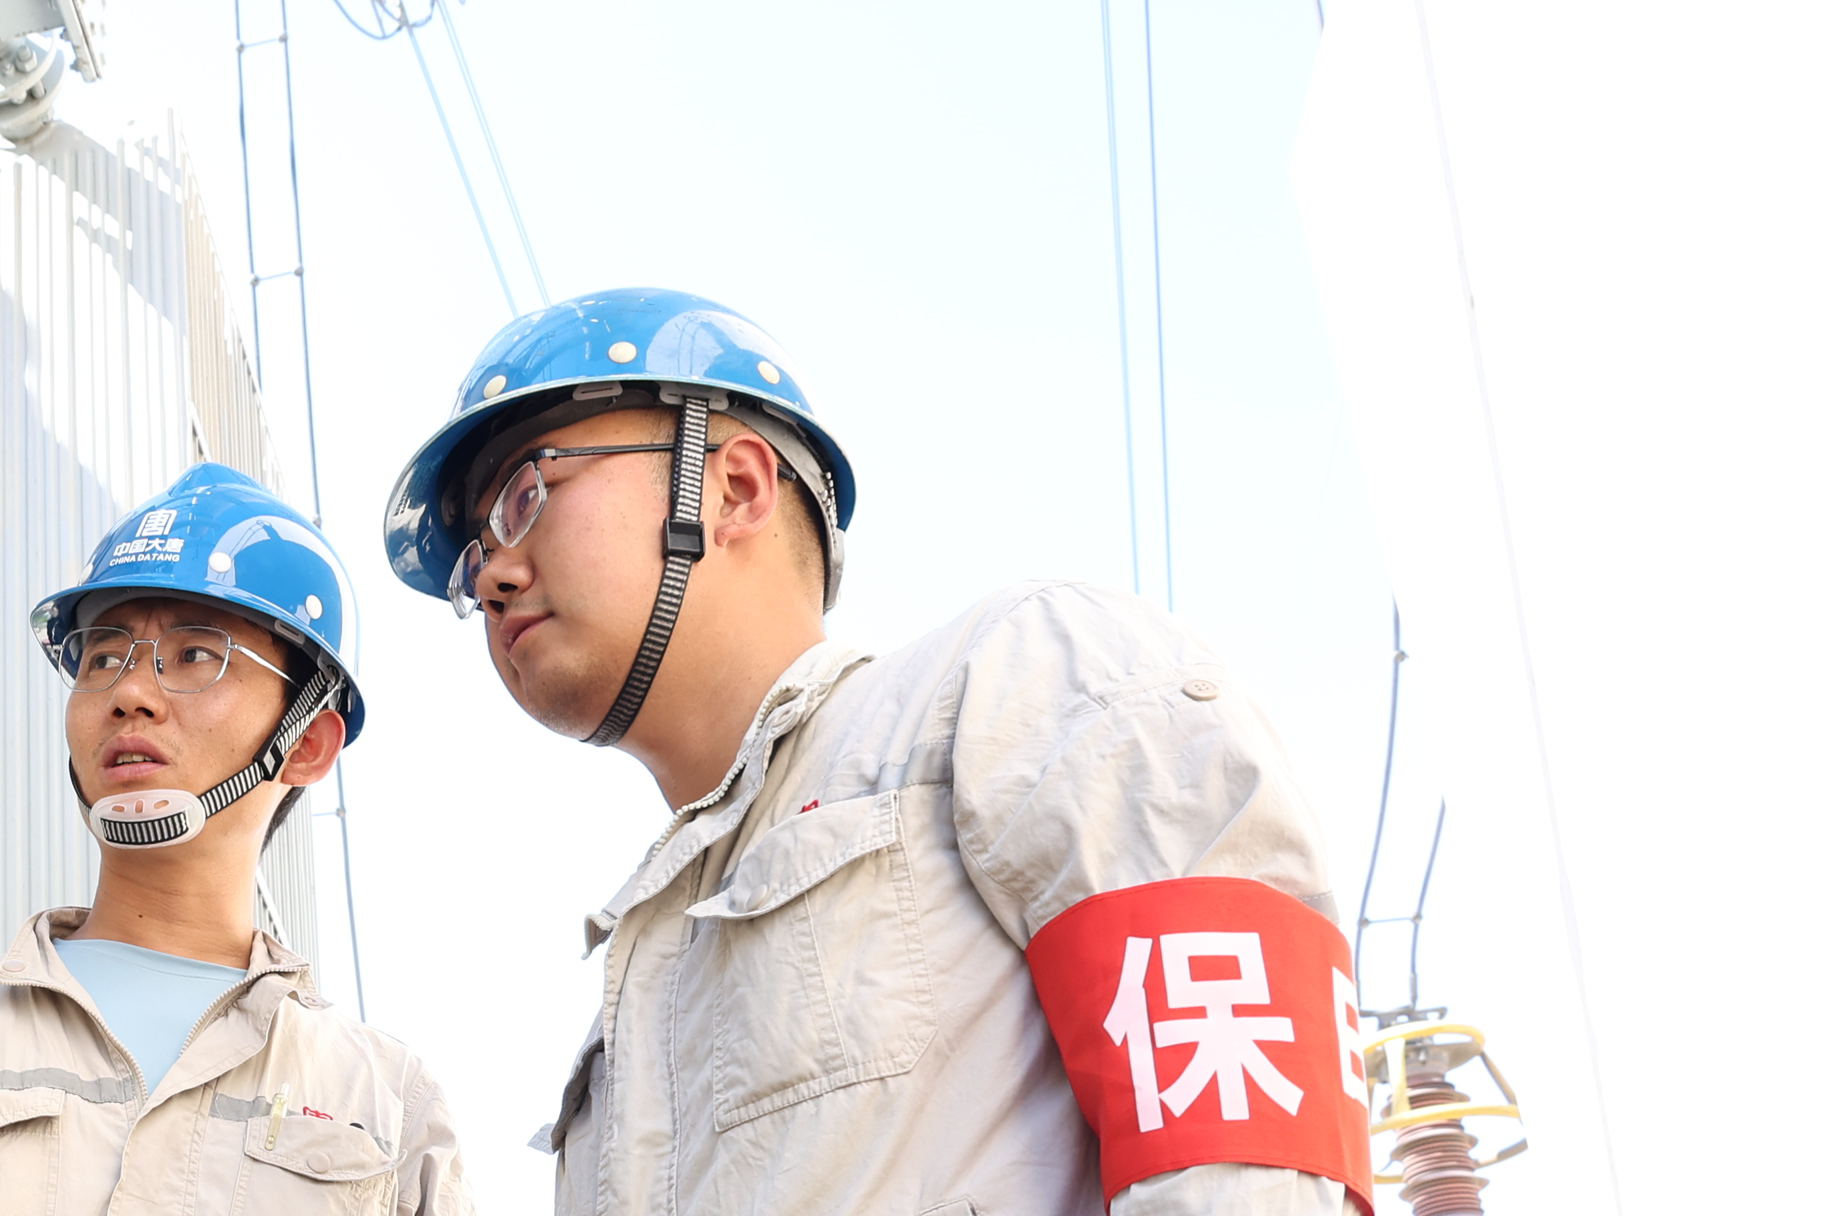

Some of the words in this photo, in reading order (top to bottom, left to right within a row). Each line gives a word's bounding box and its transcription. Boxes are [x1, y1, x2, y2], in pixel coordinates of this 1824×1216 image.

[113, 537, 185, 557] 中国大唐
[109, 554, 136, 567] CHINA
